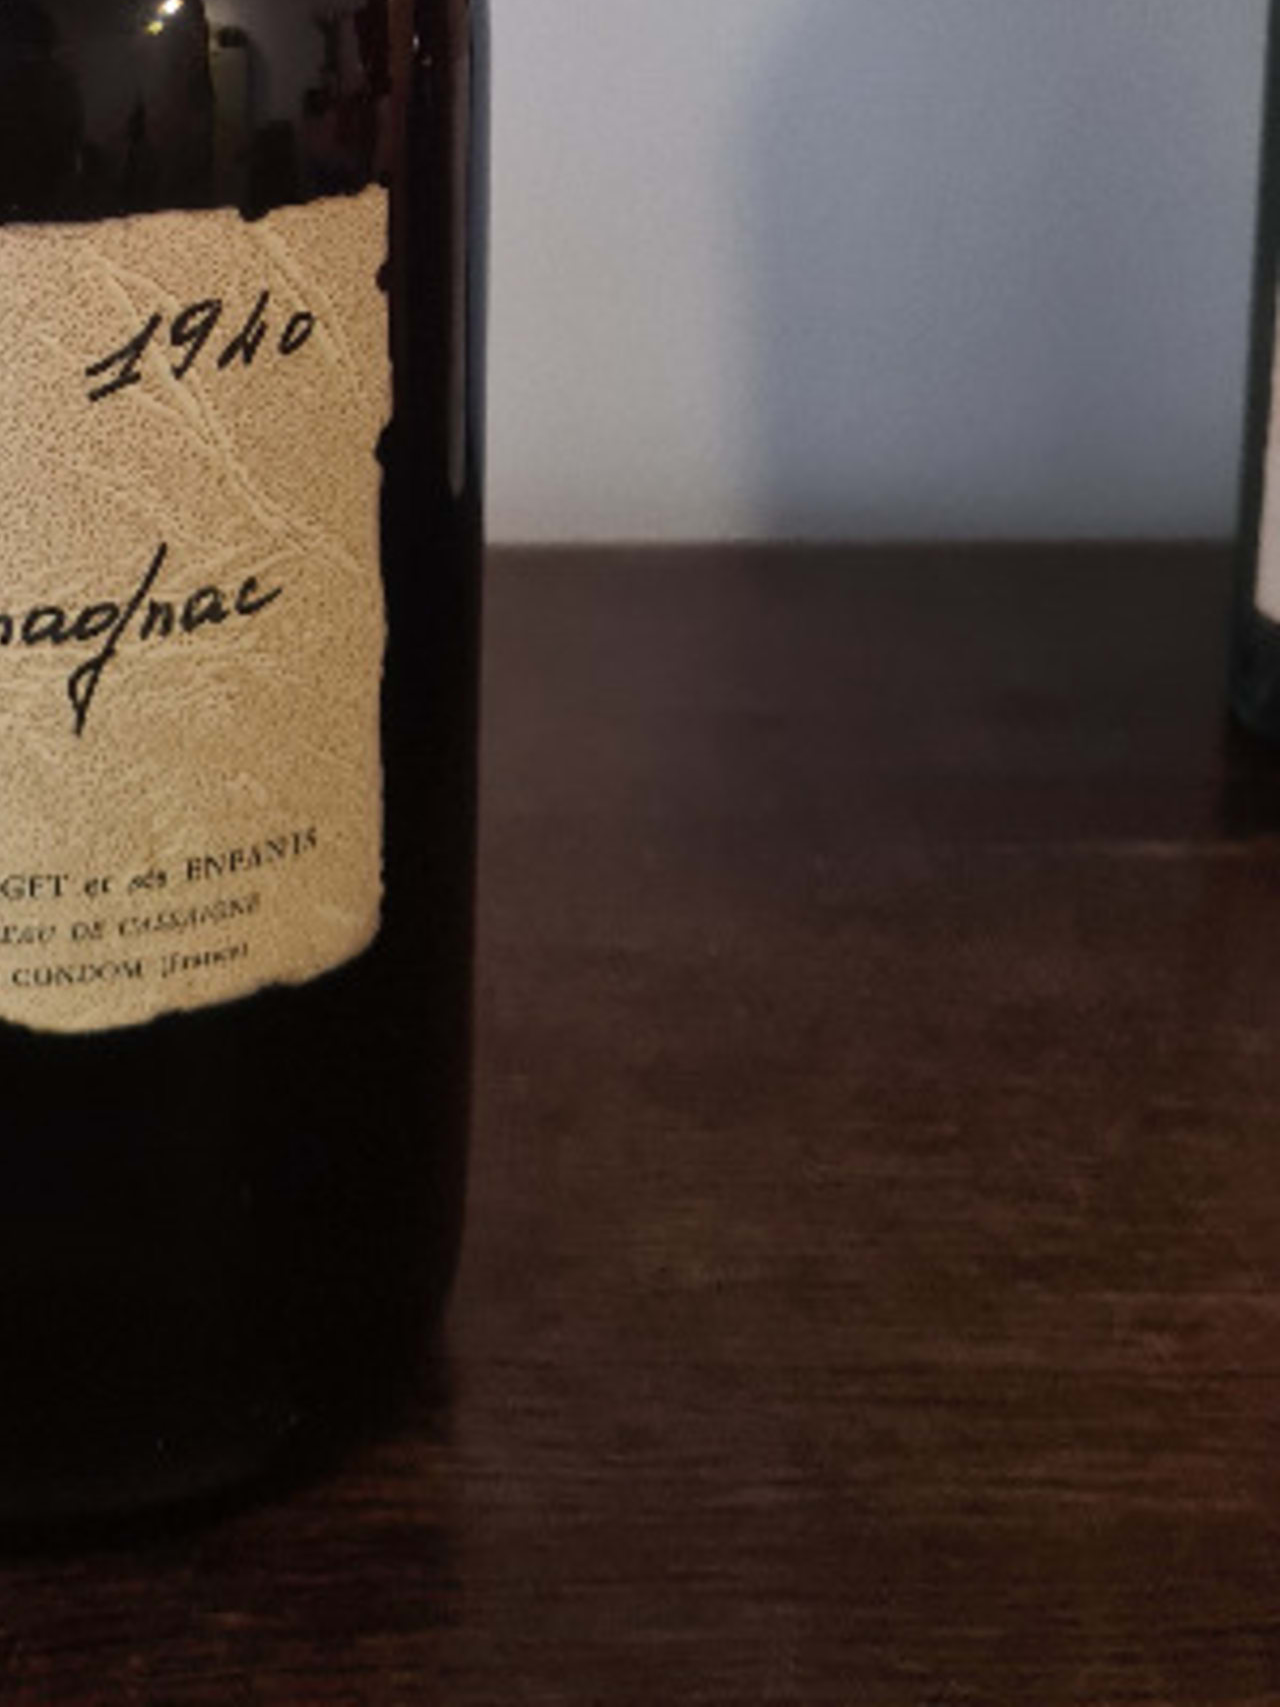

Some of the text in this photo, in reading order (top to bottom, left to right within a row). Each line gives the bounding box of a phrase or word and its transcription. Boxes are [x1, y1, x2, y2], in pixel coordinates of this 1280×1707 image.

[85, 290, 312, 402] 1940
[83, 874, 115, 901] et
[185, 824, 318, 882] ENFANTS
[70, 918, 106, 943] DE
[11, 956, 144, 988] CONDOM
